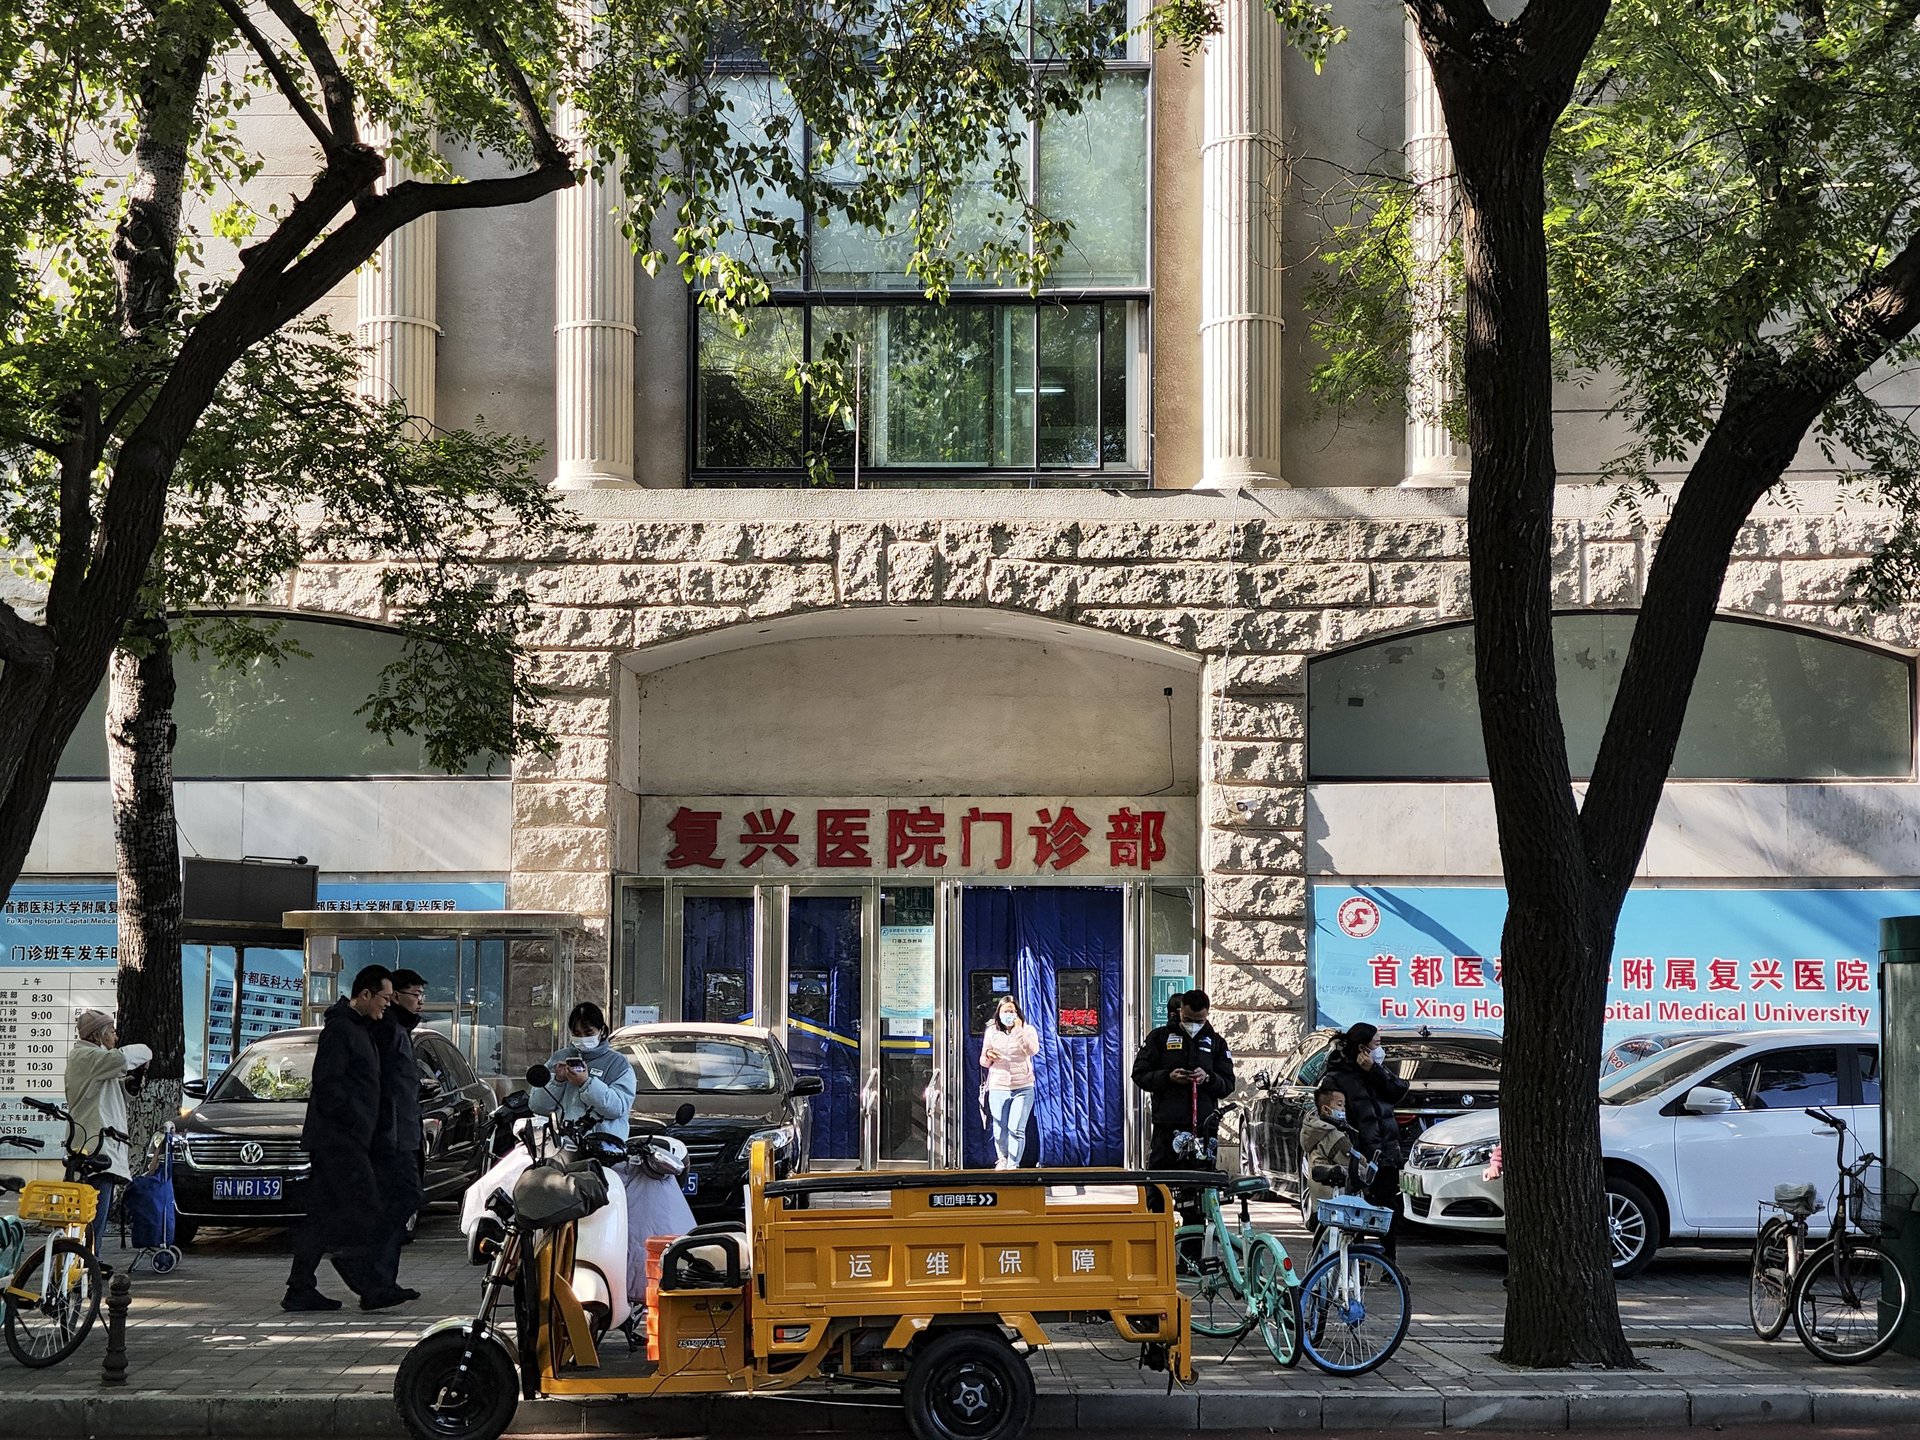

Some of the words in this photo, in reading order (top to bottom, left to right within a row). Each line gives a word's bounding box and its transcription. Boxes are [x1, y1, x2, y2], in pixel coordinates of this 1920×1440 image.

[666, 806, 1167, 871] 复兴医院门诊部
[17, 917, 33, 926] Xing
[34, 917, 62, 926] Hospital
[64, 917, 89, 926] Capital
[1368, 955, 1502, 989] 首都医
[21, 977, 42, 986] 上午
[32, 993, 53, 1003] 8:30
[31, 1011, 53, 1020] 9:00
[1381, 999, 1408, 1018] Fu
[1415, 999, 1467, 1022] Xing
[1658, 1002, 1747, 1022] Medical
[1754, 1003, 1871, 1027] University
[30, 1028, 52, 1037] 9:30
[27, 1044, 54, 1053] 10:00
[26, 1062, 53, 1071] 10:30
[26, 1079, 53, 1088] 11:00
[932, 1194, 978, 1207] 美团单车
